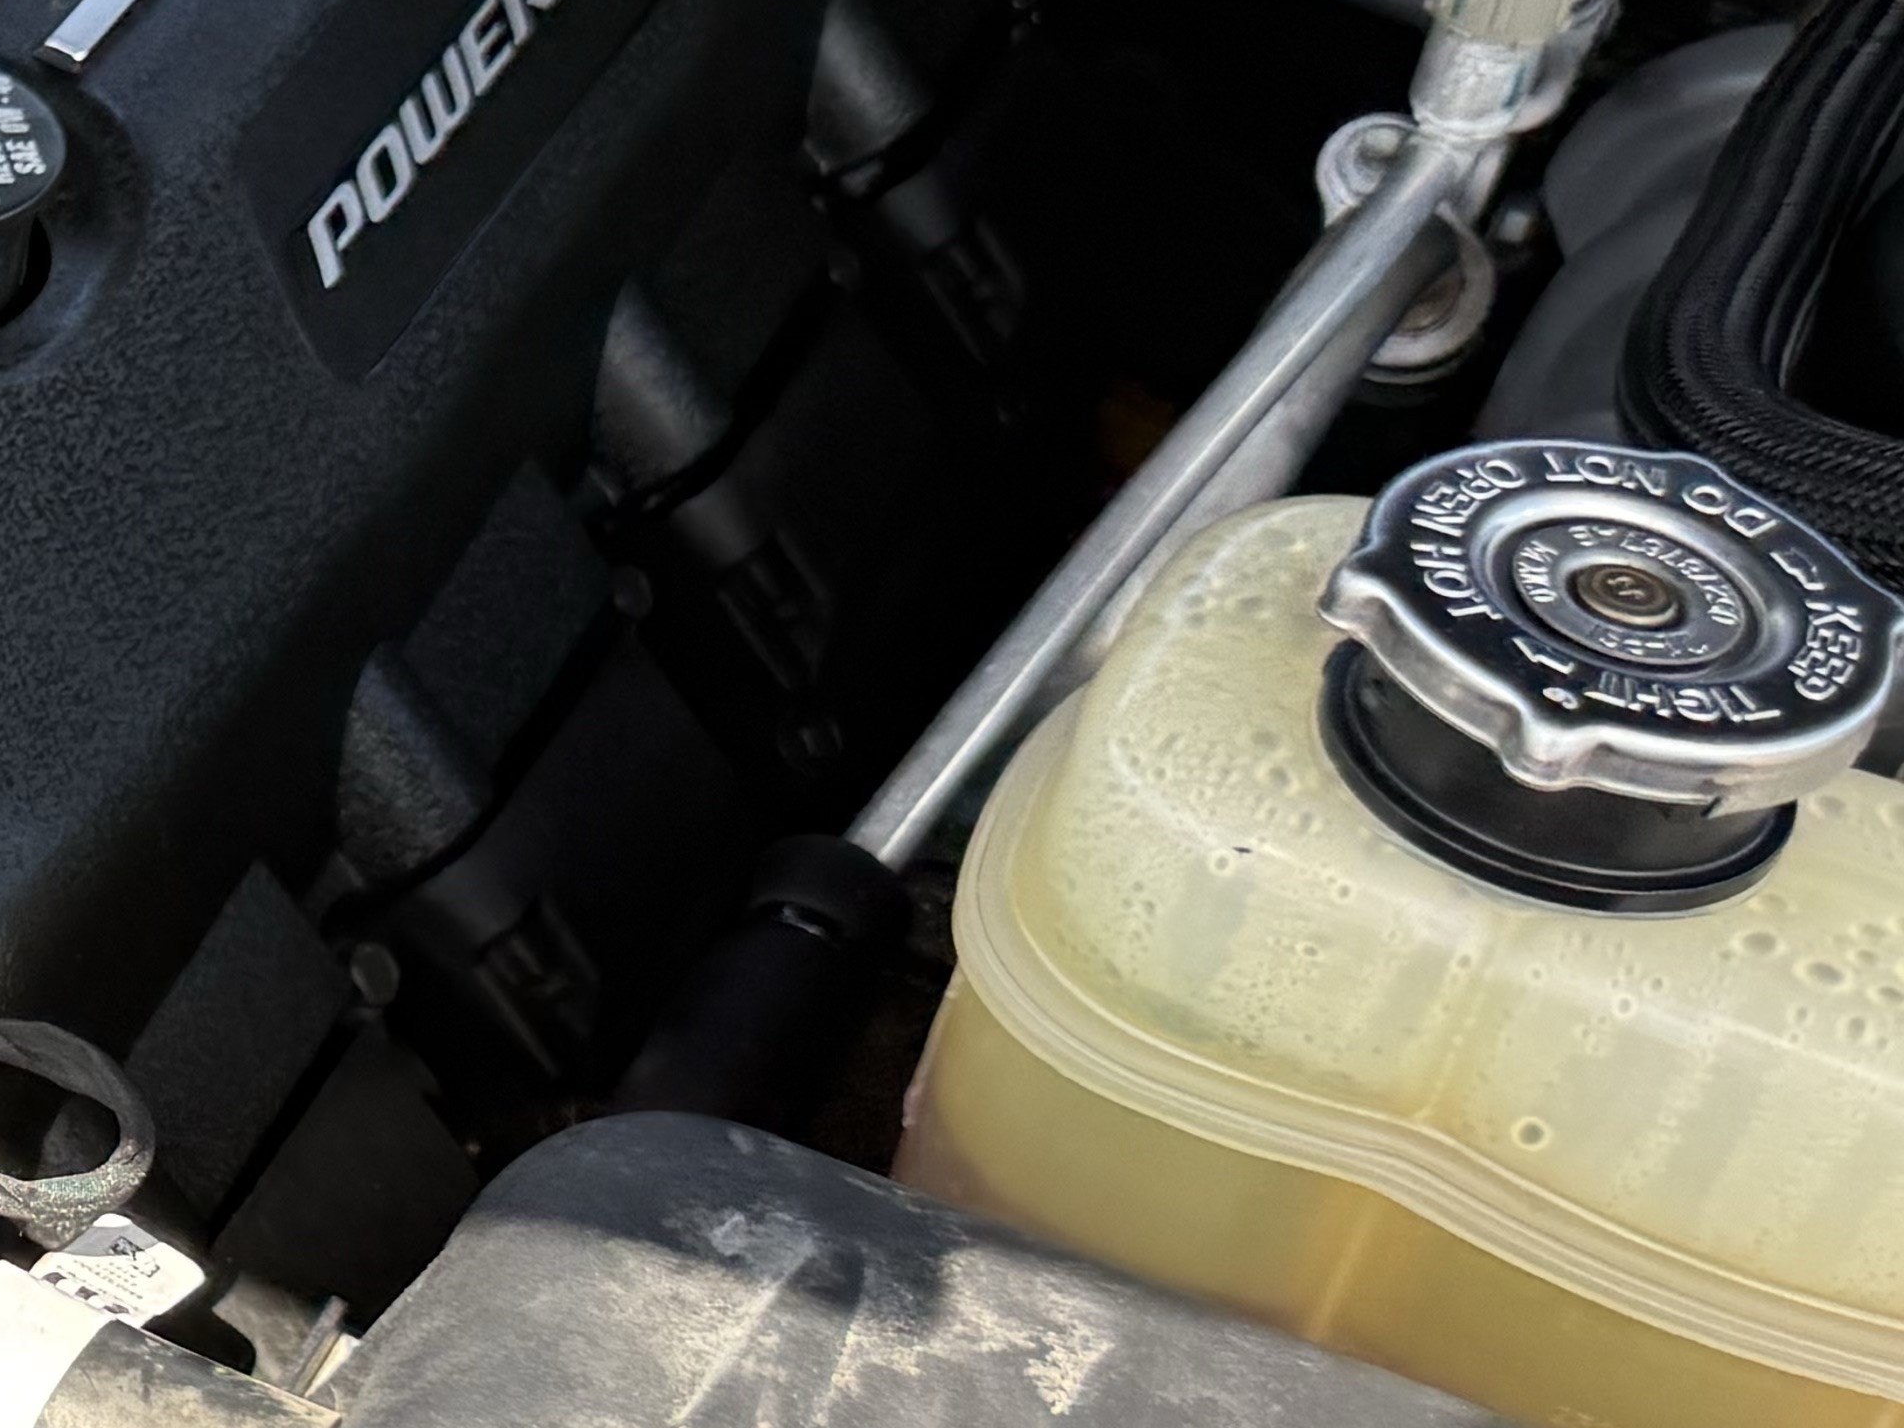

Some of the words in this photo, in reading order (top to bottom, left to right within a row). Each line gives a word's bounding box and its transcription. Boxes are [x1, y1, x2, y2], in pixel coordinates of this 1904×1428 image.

[6, 139, 47, 175] SAE
[1410, 458, 1527, 538] OPEN
[1543, 452, 1666, 497] NOT
[1681, 484, 1778, 538] DO
[1410, 541, 1504, 620] HOT
[1787, 599, 1864, 701] KEEP
[1583, 672, 1782, 723] TIGHT
